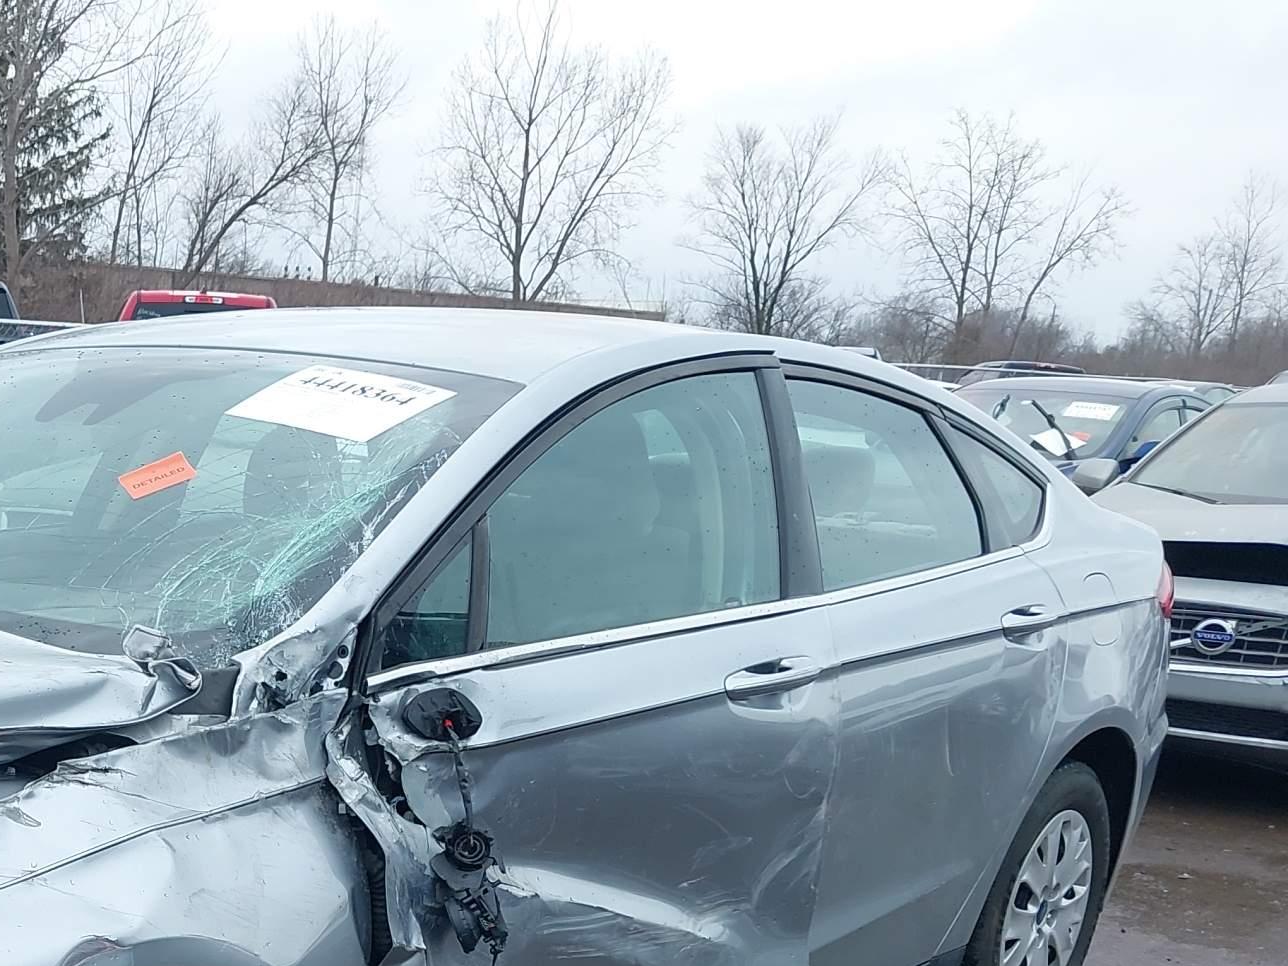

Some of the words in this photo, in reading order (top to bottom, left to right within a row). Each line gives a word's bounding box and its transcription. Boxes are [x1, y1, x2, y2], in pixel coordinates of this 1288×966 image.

[298, 376, 417, 406] 44418364
[132, 466, 185, 490] DETAILED
[1196, 632, 1231, 641] VOLVO
